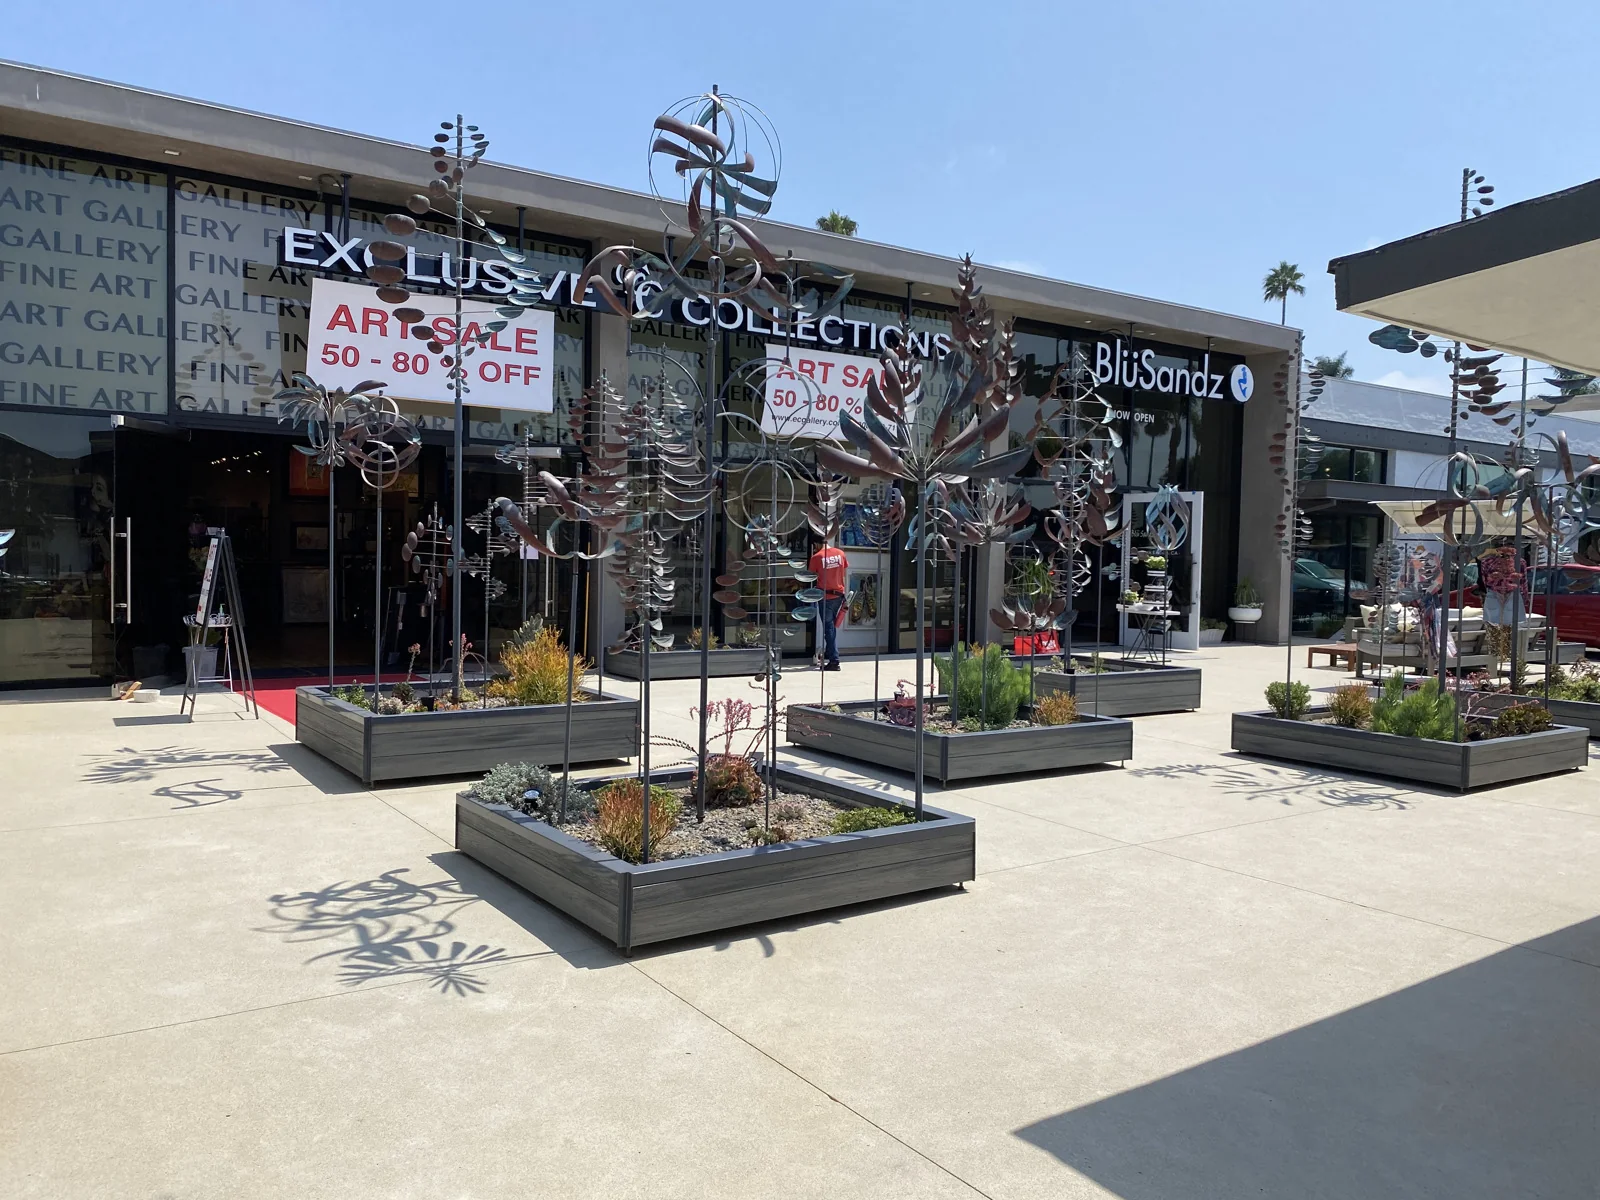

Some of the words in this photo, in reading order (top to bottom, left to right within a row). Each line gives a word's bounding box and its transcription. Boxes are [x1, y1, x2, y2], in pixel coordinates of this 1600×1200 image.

[0, 149, 76, 182] FINE
[89, 164, 157, 194] ART
[174, 180, 319, 222] GALLERY
[0, 187, 71, 216] ART
[0, 224, 161, 265] GALLERY
[190, 250, 258, 280] FINE
[0, 260, 77, 290] FINE
[89, 272, 158, 299] ART
[174, 283, 310, 321] GALLERY
[0, 300, 72, 328] ART
[265, 330, 308, 353] FIN
[431, 316, 538, 355] SALE
[0, 341, 163, 376] GALLERY
[190, 360, 259, 387] FINE
[320, 343, 361, 368] 50
[391, 351, 430, 375] 80
[478, 360, 542, 386] OFF
[1096, 338, 1224, 400] BlüSandz
[0, 380, 78, 407] FINE
[89, 387, 159, 412] ART
[772, 388, 797, 409] 50
[815, 394, 840, 413] 80
[1113, 409, 1130, 421] OW
[1133, 412, 1155, 424] OPEN
[772, 413, 841, 427] www.ecgallery.co
